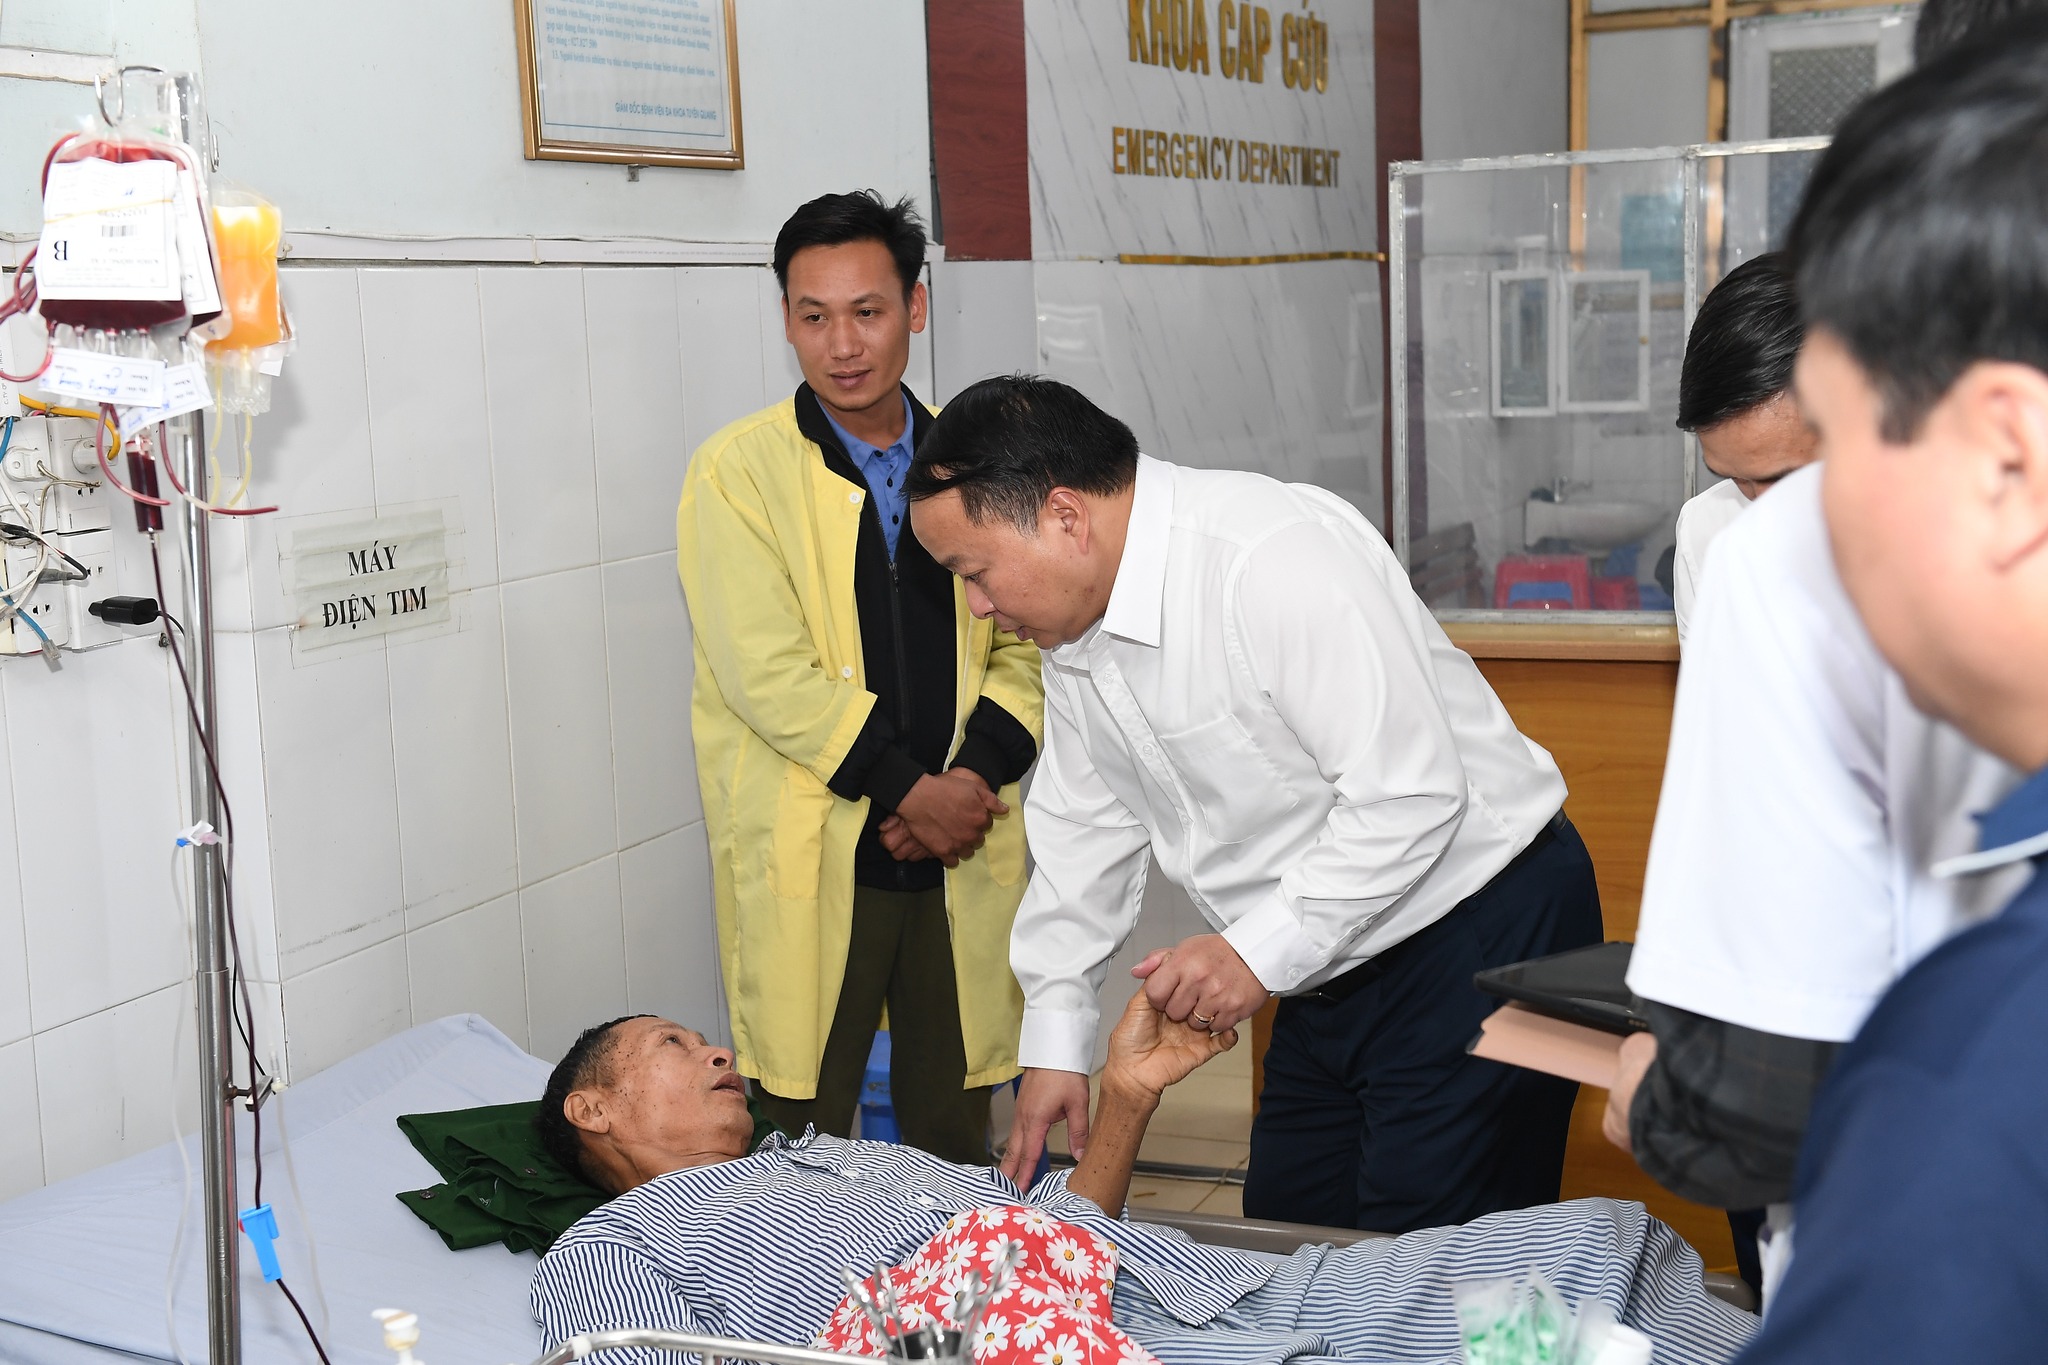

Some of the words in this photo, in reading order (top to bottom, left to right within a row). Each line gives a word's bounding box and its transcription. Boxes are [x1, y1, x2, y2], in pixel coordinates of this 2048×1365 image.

[1128, 0, 1210, 75] KHOA
[1112, 126, 1233, 180] EMERGENCY
[1238, 140, 1340, 188] DEPARTMENT
[54, 241, 67, 261] B
[347, 540, 397, 576] MÁY
[322, 593, 376, 629] ĐIỆN
[386, 586, 427, 615] TIM
